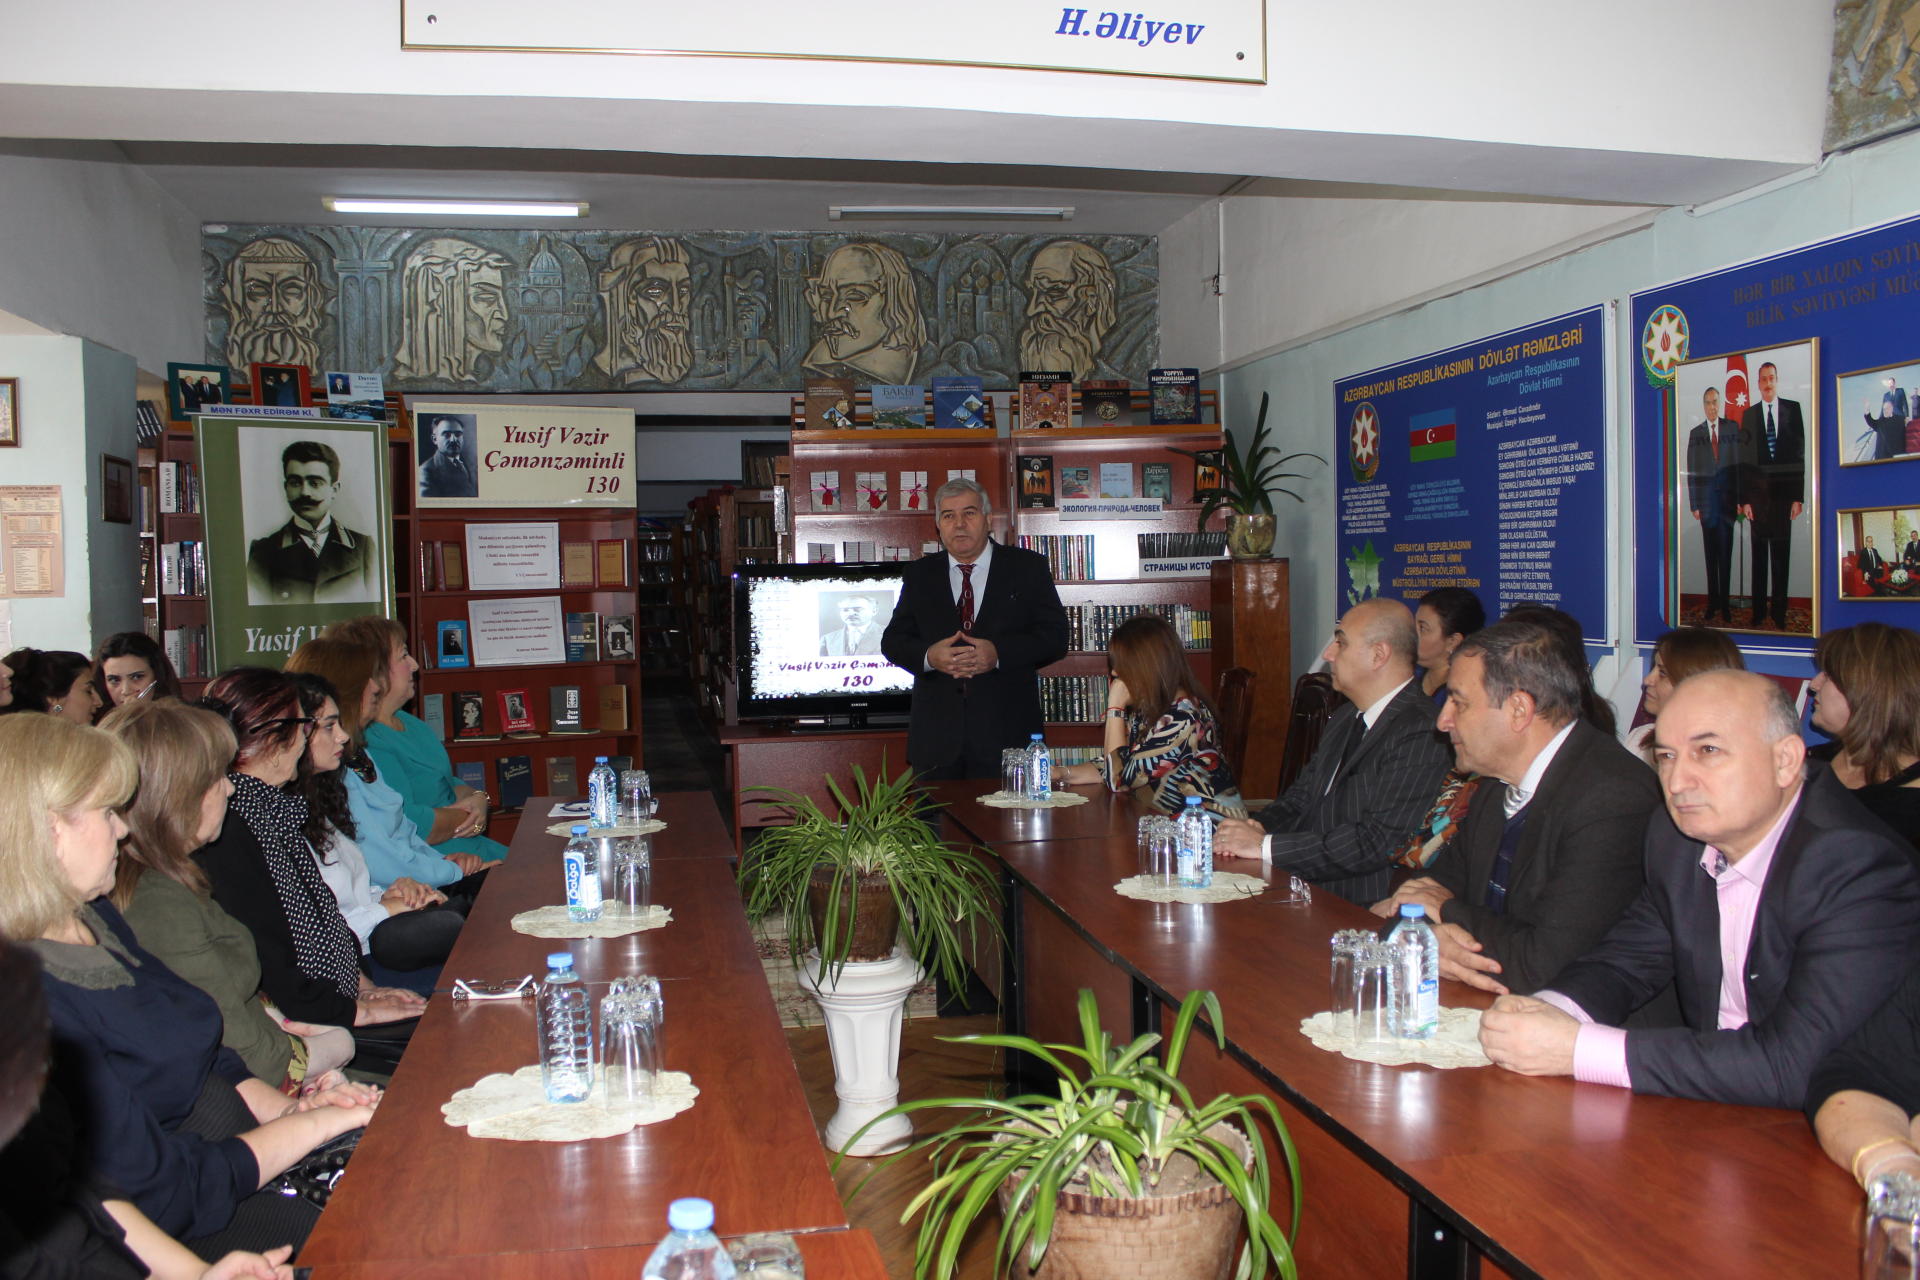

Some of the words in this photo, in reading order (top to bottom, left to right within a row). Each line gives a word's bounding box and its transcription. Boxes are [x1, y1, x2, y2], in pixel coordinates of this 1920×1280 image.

[1055, 8, 1205, 47] H.Əliyev
[1734, 282, 1764, 304] HƏR
[1772, 272, 1797, 296] BİR
[1802, 258, 1863, 287] XALQIN
[1747, 303, 1785, 328] BİLİK
[1792, 277, 1877, 317] SƏVİYYƏSİ
[1344, 380, 1394, 403] AZƏRBAYCAN
[1398, 357, 1473, 391] RESPUBLİKASININ
[1479, 345, 1519, 370] DÖVLƏT
[1523, 324, 1582, 358] RƏMZLƏRİ
[1488, 369, 1522, 386] Azərbaycan
[1525, 357, 1579, 377] Respublikasının
[1520, 380, 1540, 394] Dövlət
[1543, 374, 1562, 389] Himni
[235, 407, 260, 415] FƏXR
[264, 407, 299, 416] EDİRƏM
[504, 426, 556, 448] Yusif
[560, 427, 610, 446] Vəzir
[484, 450, 626, 472] Çəmənzəminli
[585, 476, 620, 494] 130
[1144, 562, 1188, 573] СТРАНИЦЫ
[1190, 562, 1211, 571] ИСТО
[244, 626, 305, 658] Yusif
[850, 660, 896, 670] Çəmən
[842, 675, 874, 687] 130
